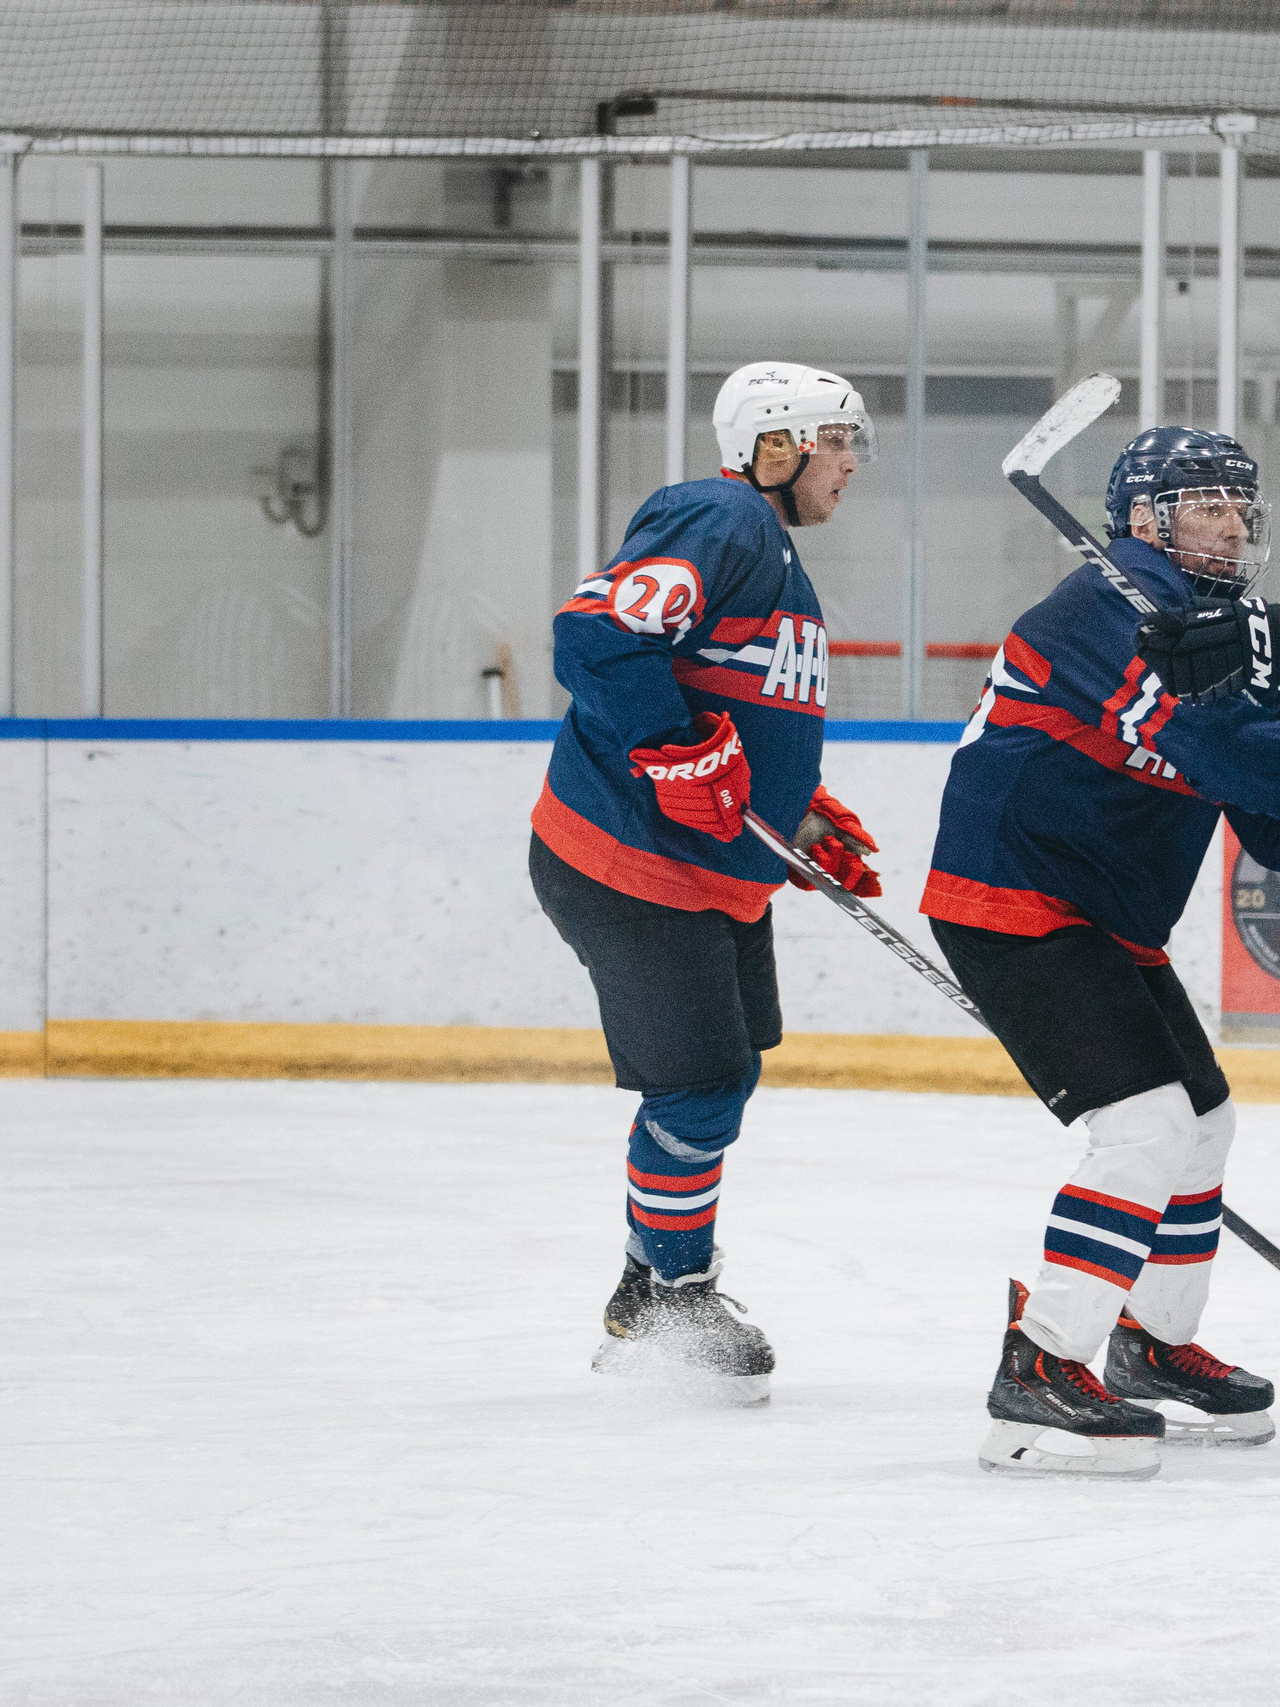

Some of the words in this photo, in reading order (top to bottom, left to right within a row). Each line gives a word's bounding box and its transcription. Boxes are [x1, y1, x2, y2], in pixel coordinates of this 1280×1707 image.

[1125, 474, 1155, 484] CCM
[1225, 459, 1253, 471] CCM
[621, 574, 692, 623] 20
[1074, 536, 1158, 614] TRUE
[760, 616, 828, 707] АТО
[1239, 596, 1273, 689] CCM
[720, 789, 734, 809] 100
[793, 848, 842, 877] CCM
[838, 902, 976, 1010] JETSPEED
